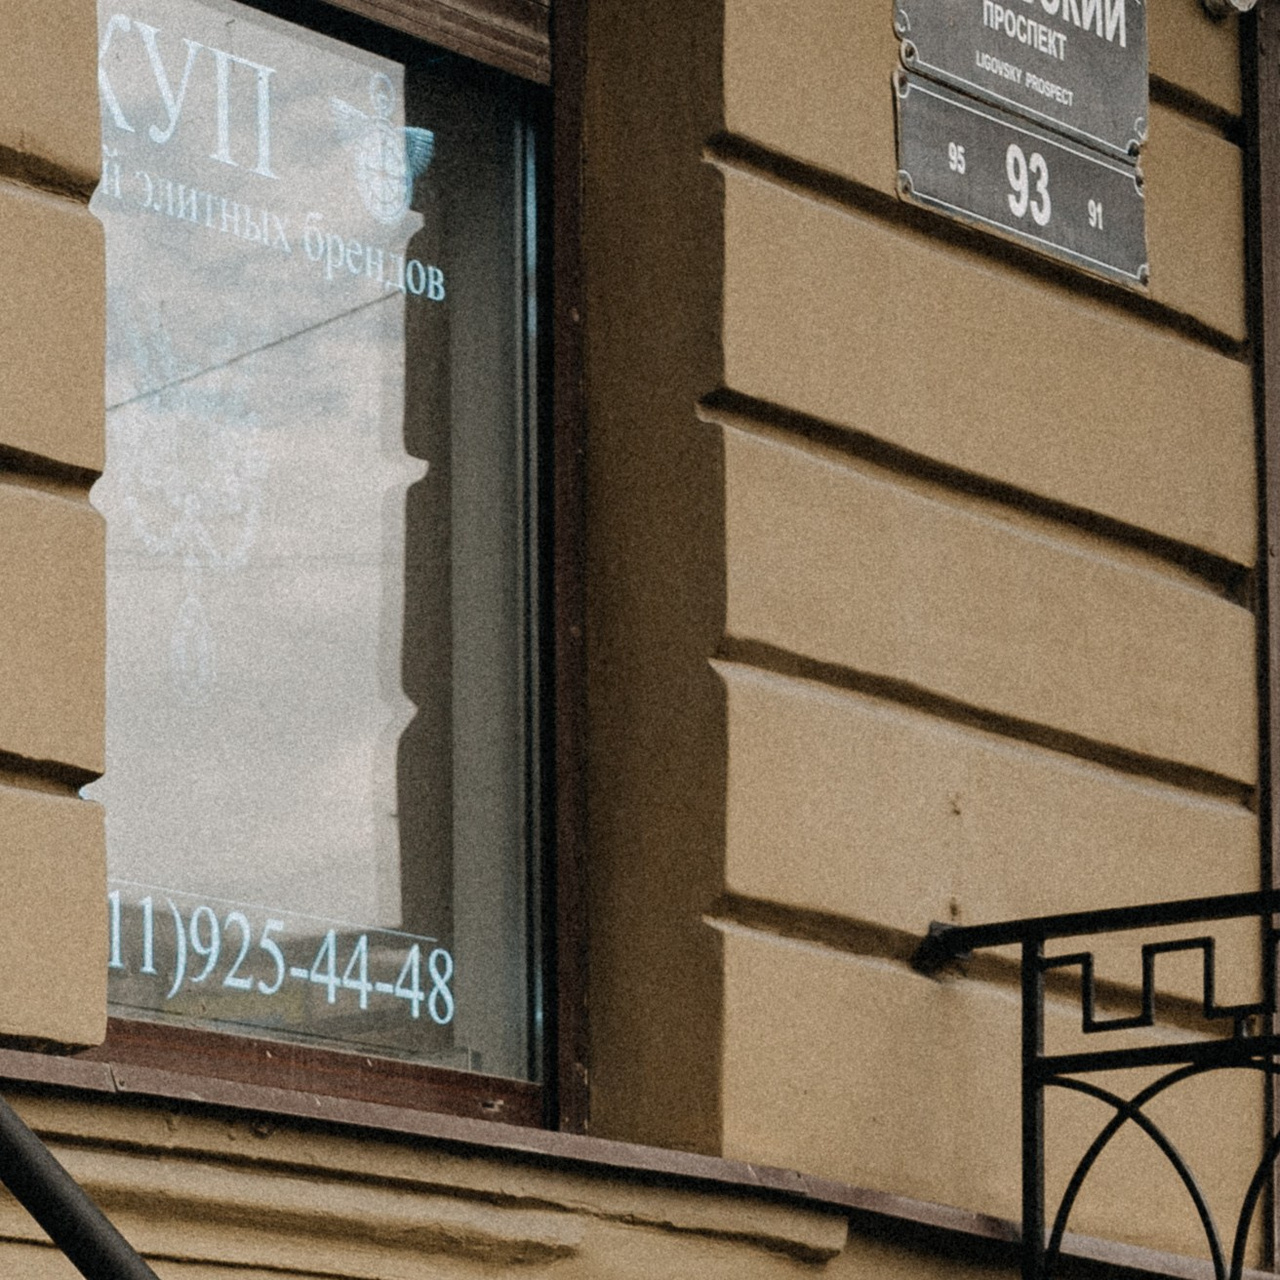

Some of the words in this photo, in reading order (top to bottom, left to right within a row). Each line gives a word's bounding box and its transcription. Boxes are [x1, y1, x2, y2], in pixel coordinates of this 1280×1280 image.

[983, 0, 1067, 61] ПРОСПЕКТ
[975, 50, 1022, 84] LIGOVSKY
[1025, 72, 1074, 106] PROSPECT
[948, 142, 966, 175] 95
[1006, 143, 1052, 227] 93
[1088, 200, 1104, 230] 91
[303, 212, 446, 301] брендов
